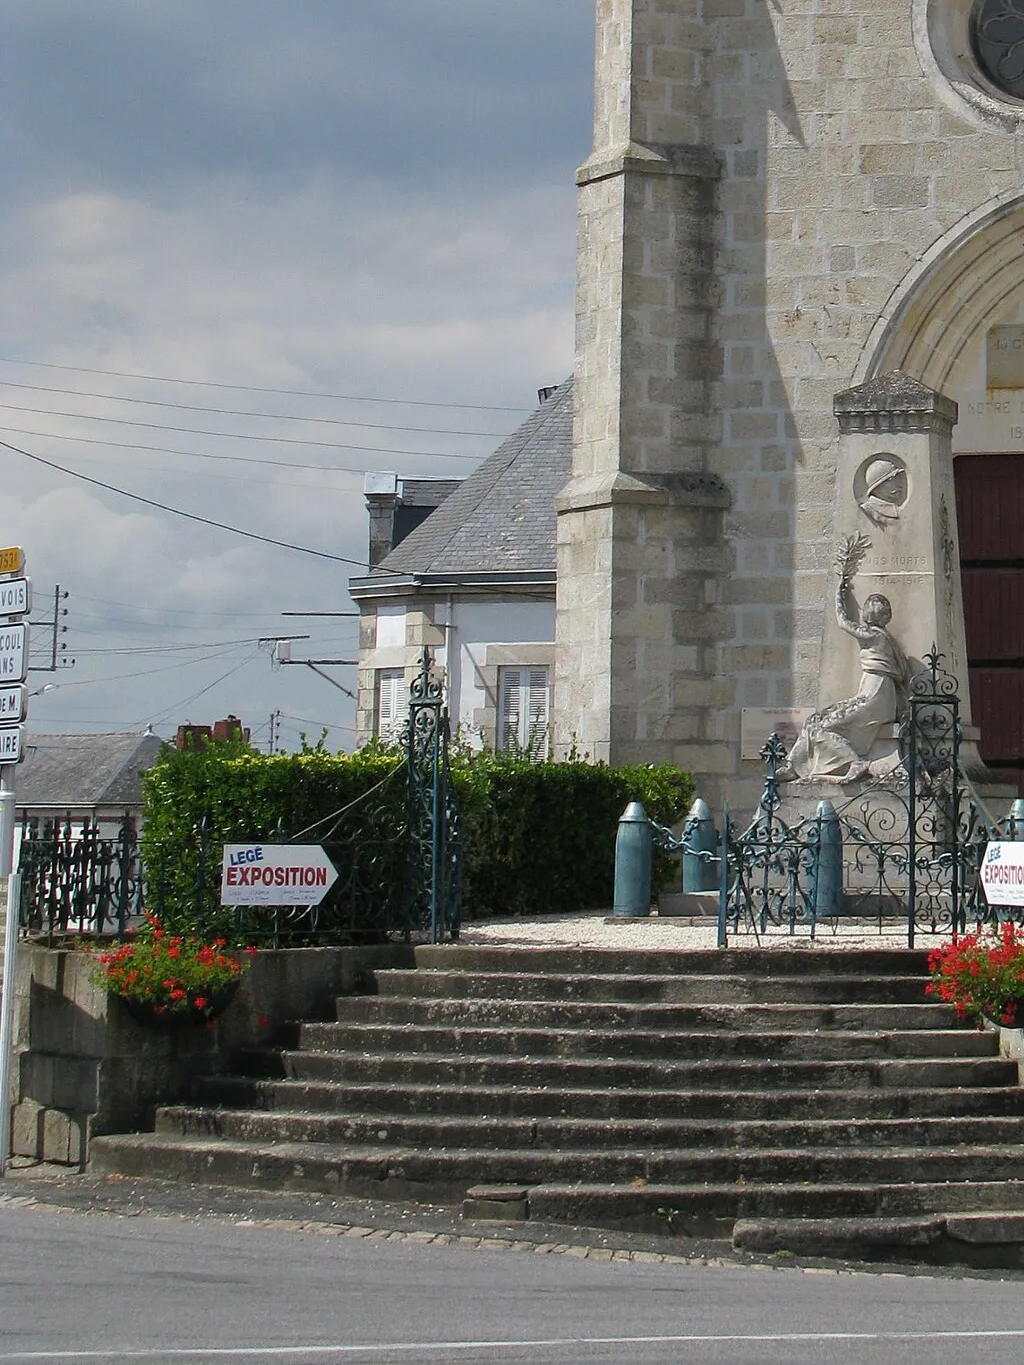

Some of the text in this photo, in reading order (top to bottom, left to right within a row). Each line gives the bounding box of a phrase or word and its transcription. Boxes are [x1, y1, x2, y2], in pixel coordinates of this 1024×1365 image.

[967, 401, 1010, 414] NOTRE
[230, 846, 264, 866] LEGÉ
[987, 843, 1002, 863] LEGÉ
[226, 866, 327, 887] EXPOSITION
